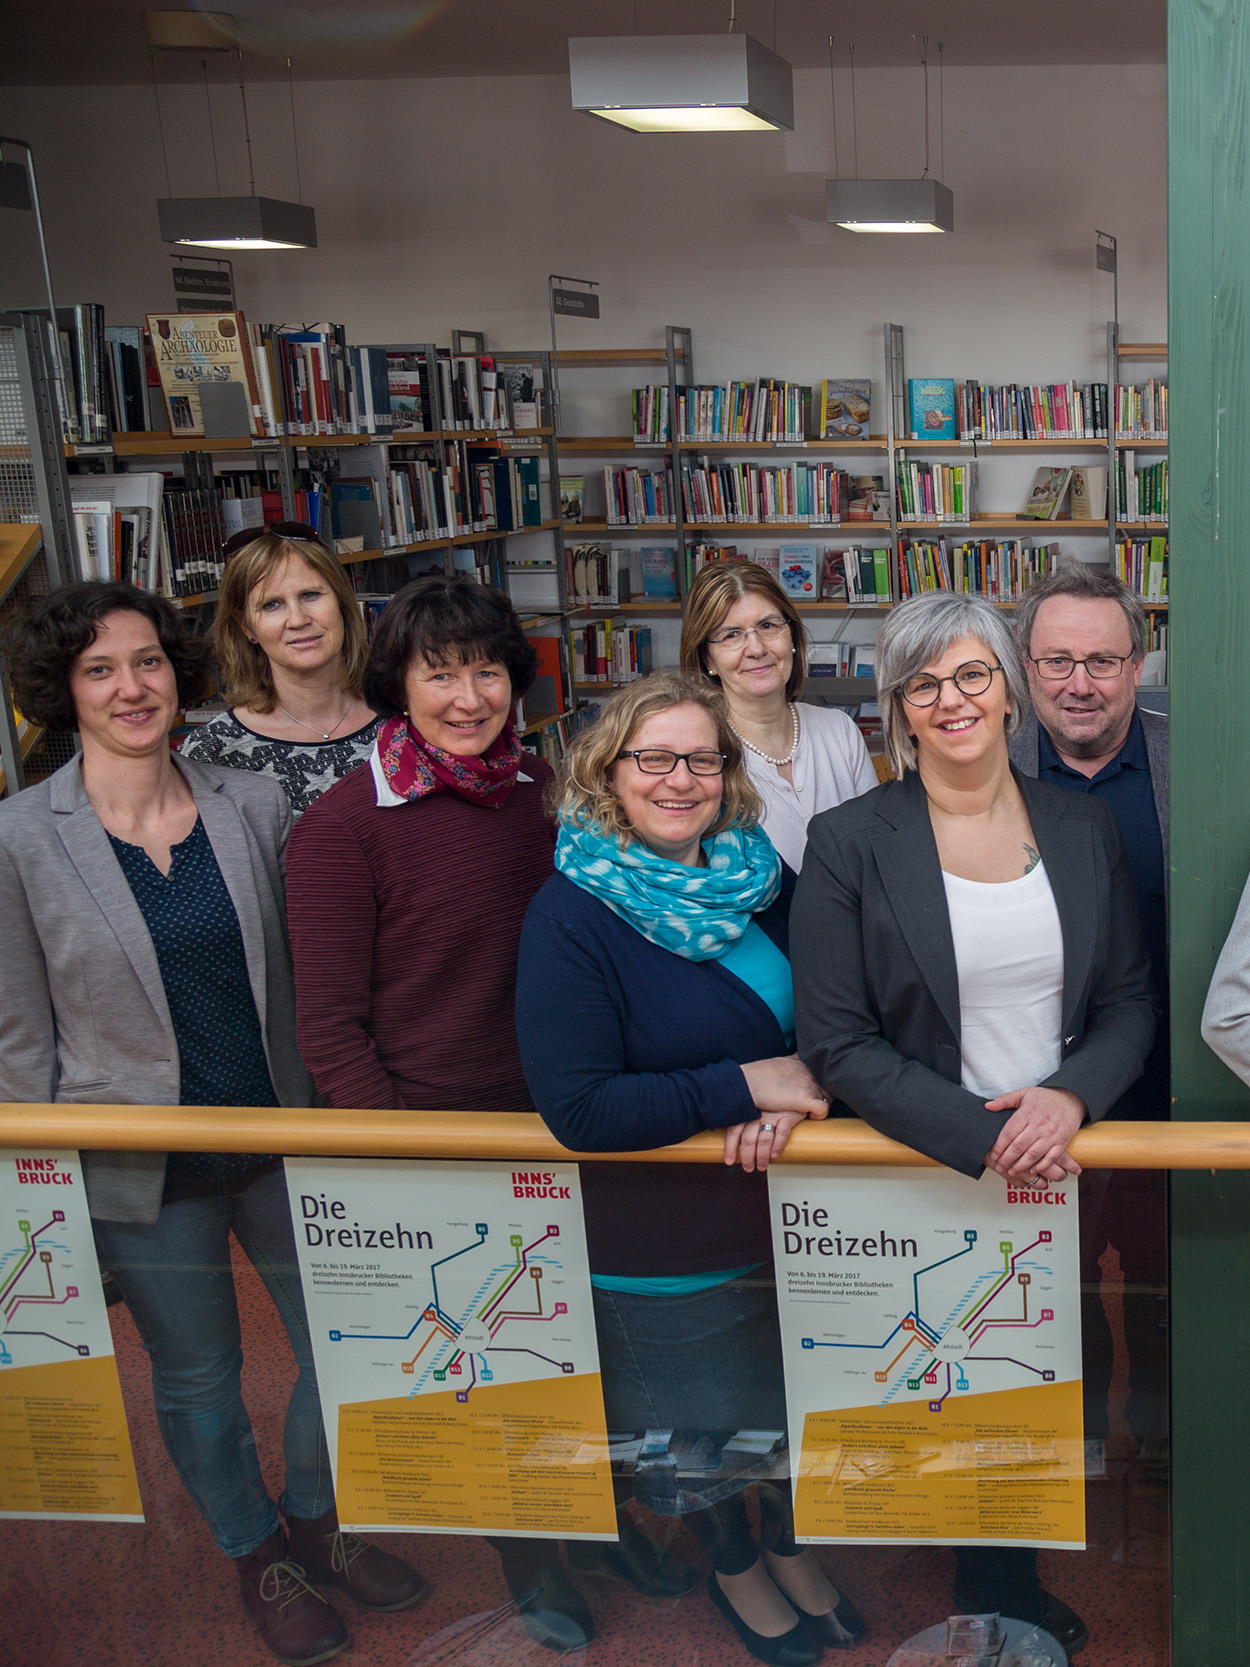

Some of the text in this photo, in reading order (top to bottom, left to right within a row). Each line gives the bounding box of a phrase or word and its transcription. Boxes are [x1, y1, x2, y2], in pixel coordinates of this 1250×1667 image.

[172, 326, 218, 340] ABENTEUER
[160, 340, 237, 360] ARCHÄOLOGIE
[15, 1158, 58, 1171] INNS'
[18, 1172, 73, 1185] BRUCK
[511, 1172, 556, 1185] INNS'
[513, 1186, 571, 1199] BRUCK
[1007, 1191, 1067, 1206] BRUCK
[300, 1193, 347, 1220] Die
[781, 1200, 829, 1228] Die
[304, 1222, 434, 1250] Dreizehn
[783, 1230, 918, 1258] Dreizehn
